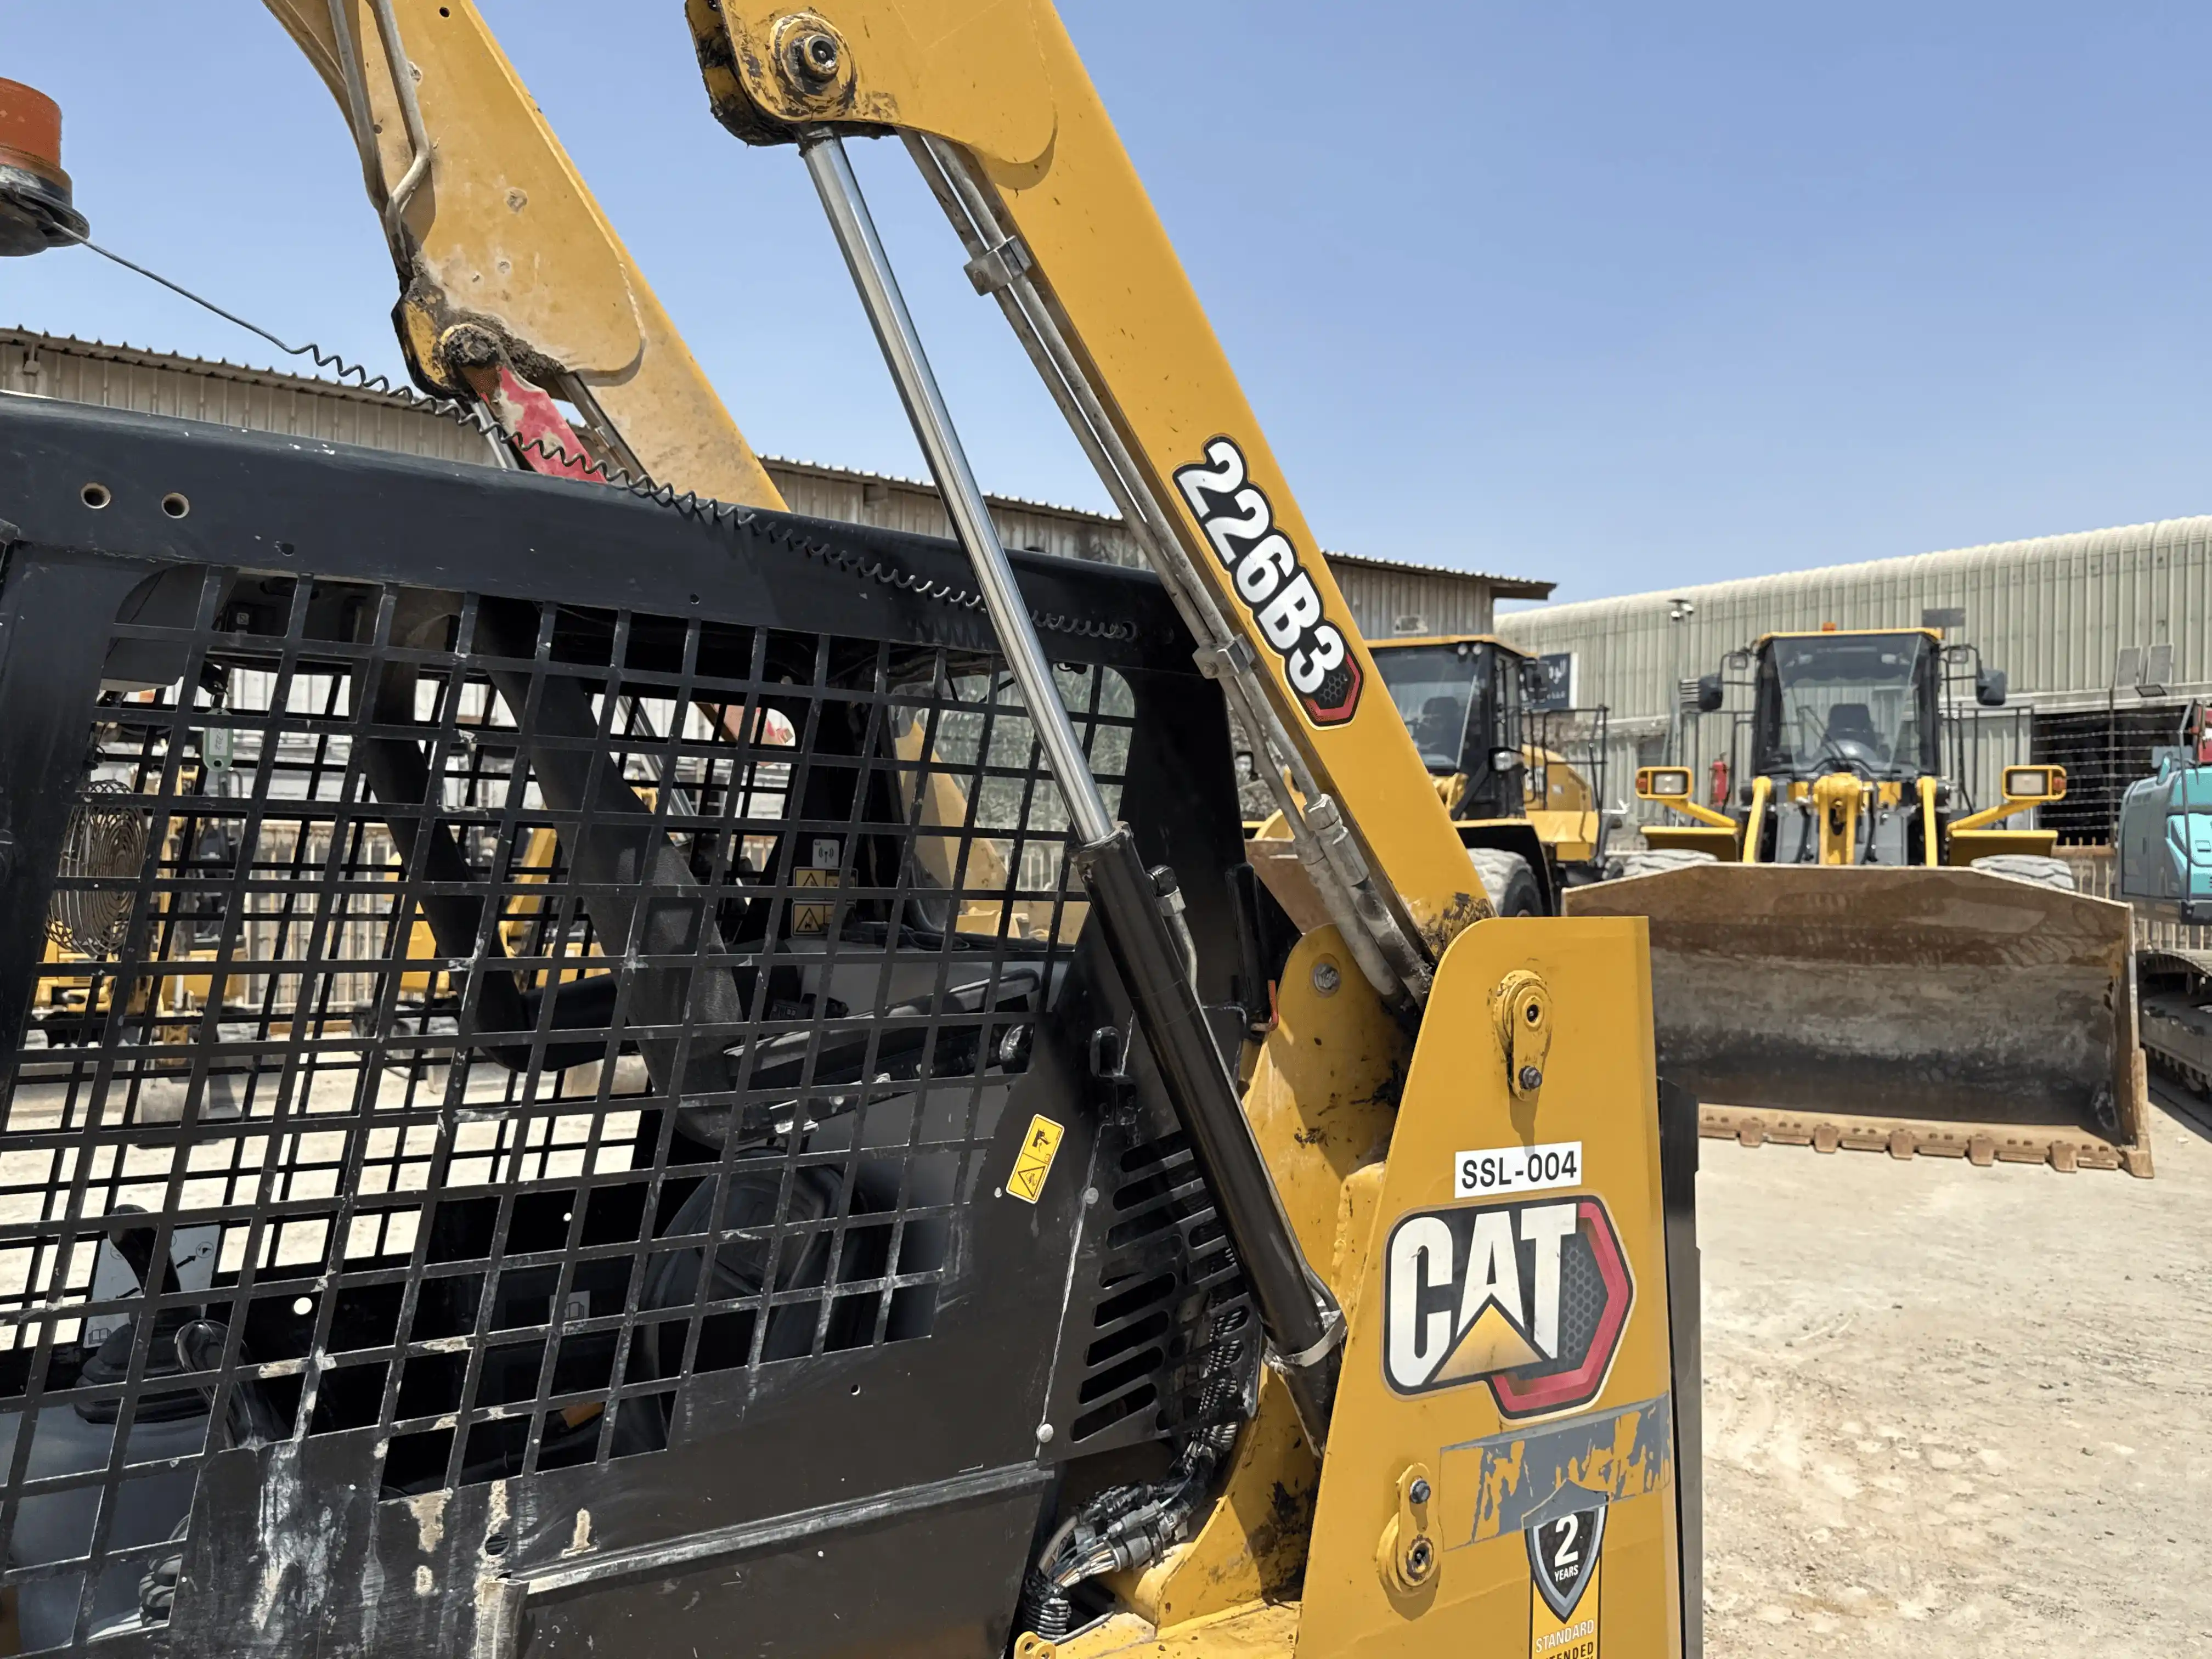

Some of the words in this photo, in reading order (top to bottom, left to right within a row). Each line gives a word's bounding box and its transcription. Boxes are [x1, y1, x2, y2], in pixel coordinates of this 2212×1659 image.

[1177, 441, 1344, 693] 226B3
[1462, 1150, 1577, 1189] SSL-004
[1389, 1203, 1577, 1387] CAT
[1554, 1513, 1578, 1567] 2
[1554, 1564, 1578, 1582] YEARS
[1536, 1619, 1594, 1653] STANDARD
